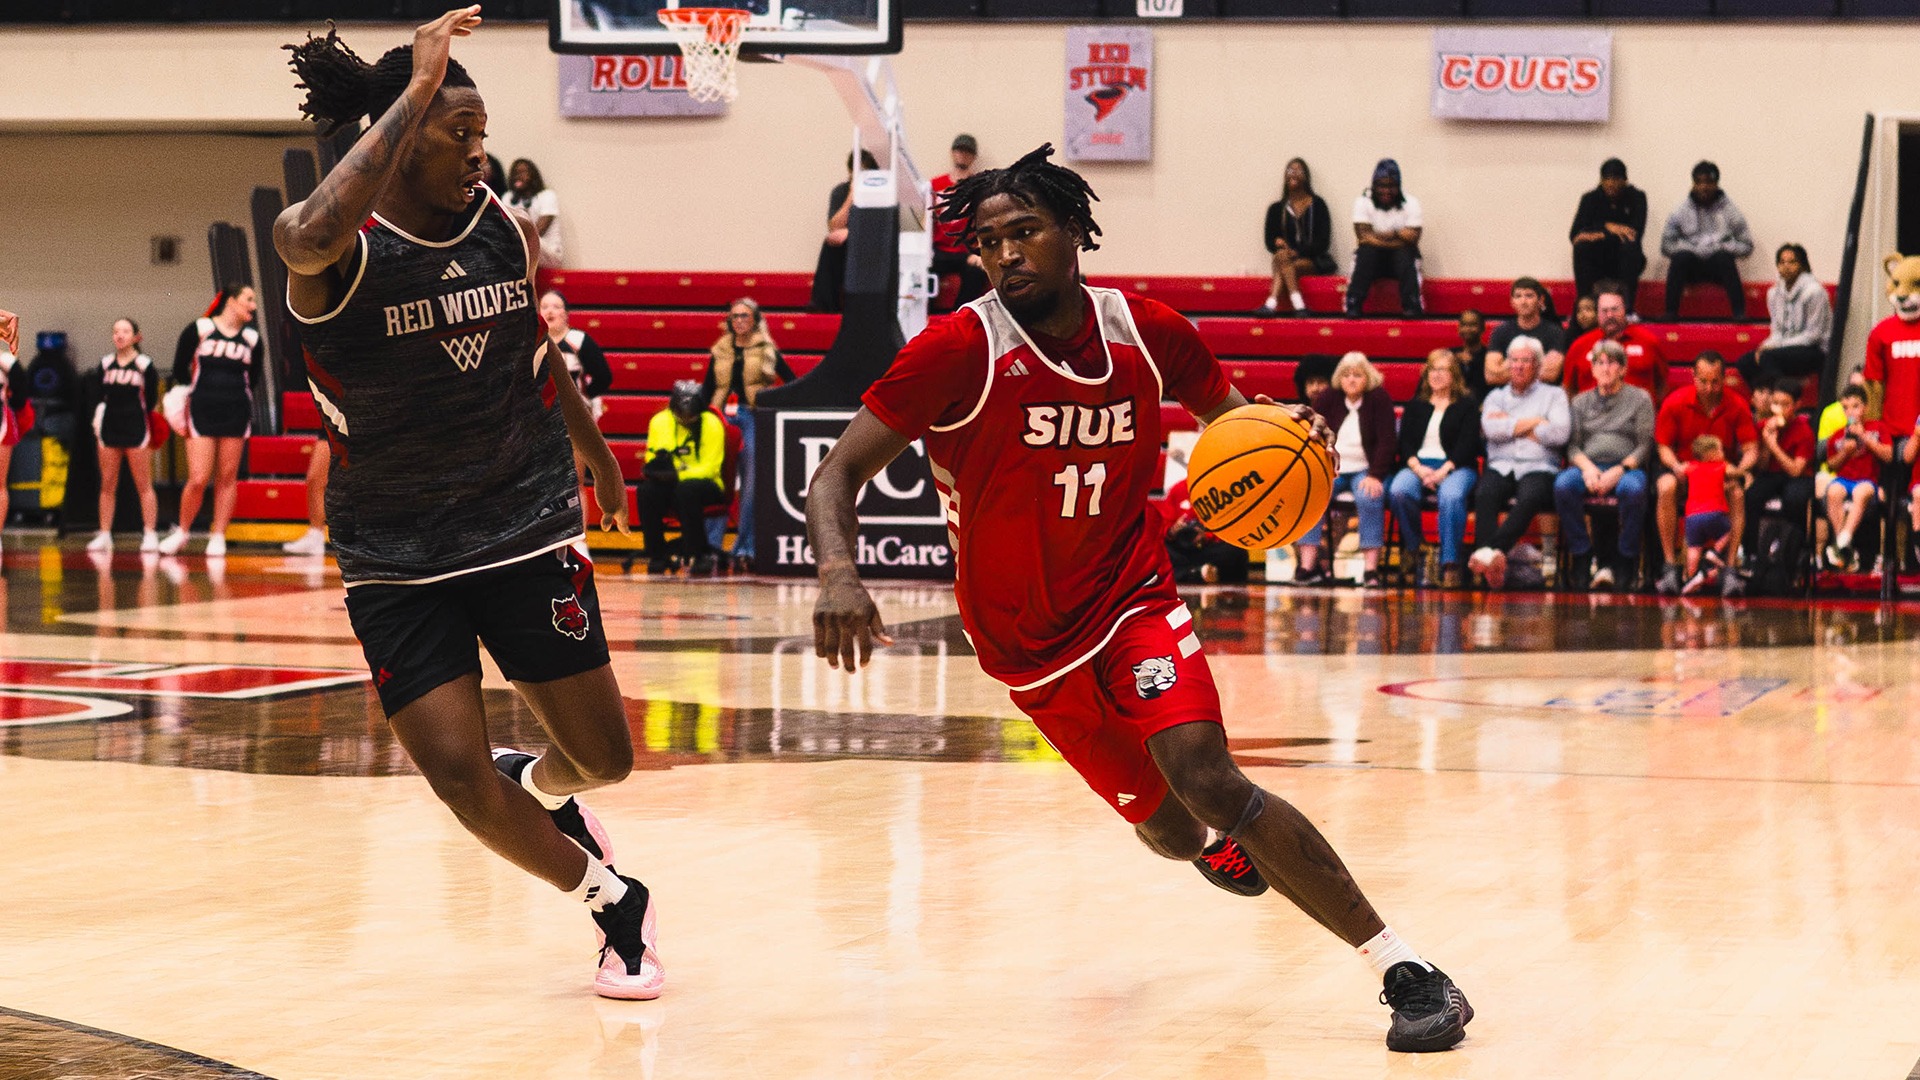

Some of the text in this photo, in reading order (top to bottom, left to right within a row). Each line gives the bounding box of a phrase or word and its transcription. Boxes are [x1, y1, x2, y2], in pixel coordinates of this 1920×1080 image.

[1440, 54, 1602, 95] COUGS
[383, 279, 529, 336] RED WOLVES
[1022, 399, 1136, 447] SIUE
[1054, 463, 1107, 517] 11
[1193, 470, 1265, 523] Wilson
[776, 534, 948, 566] HehCare
